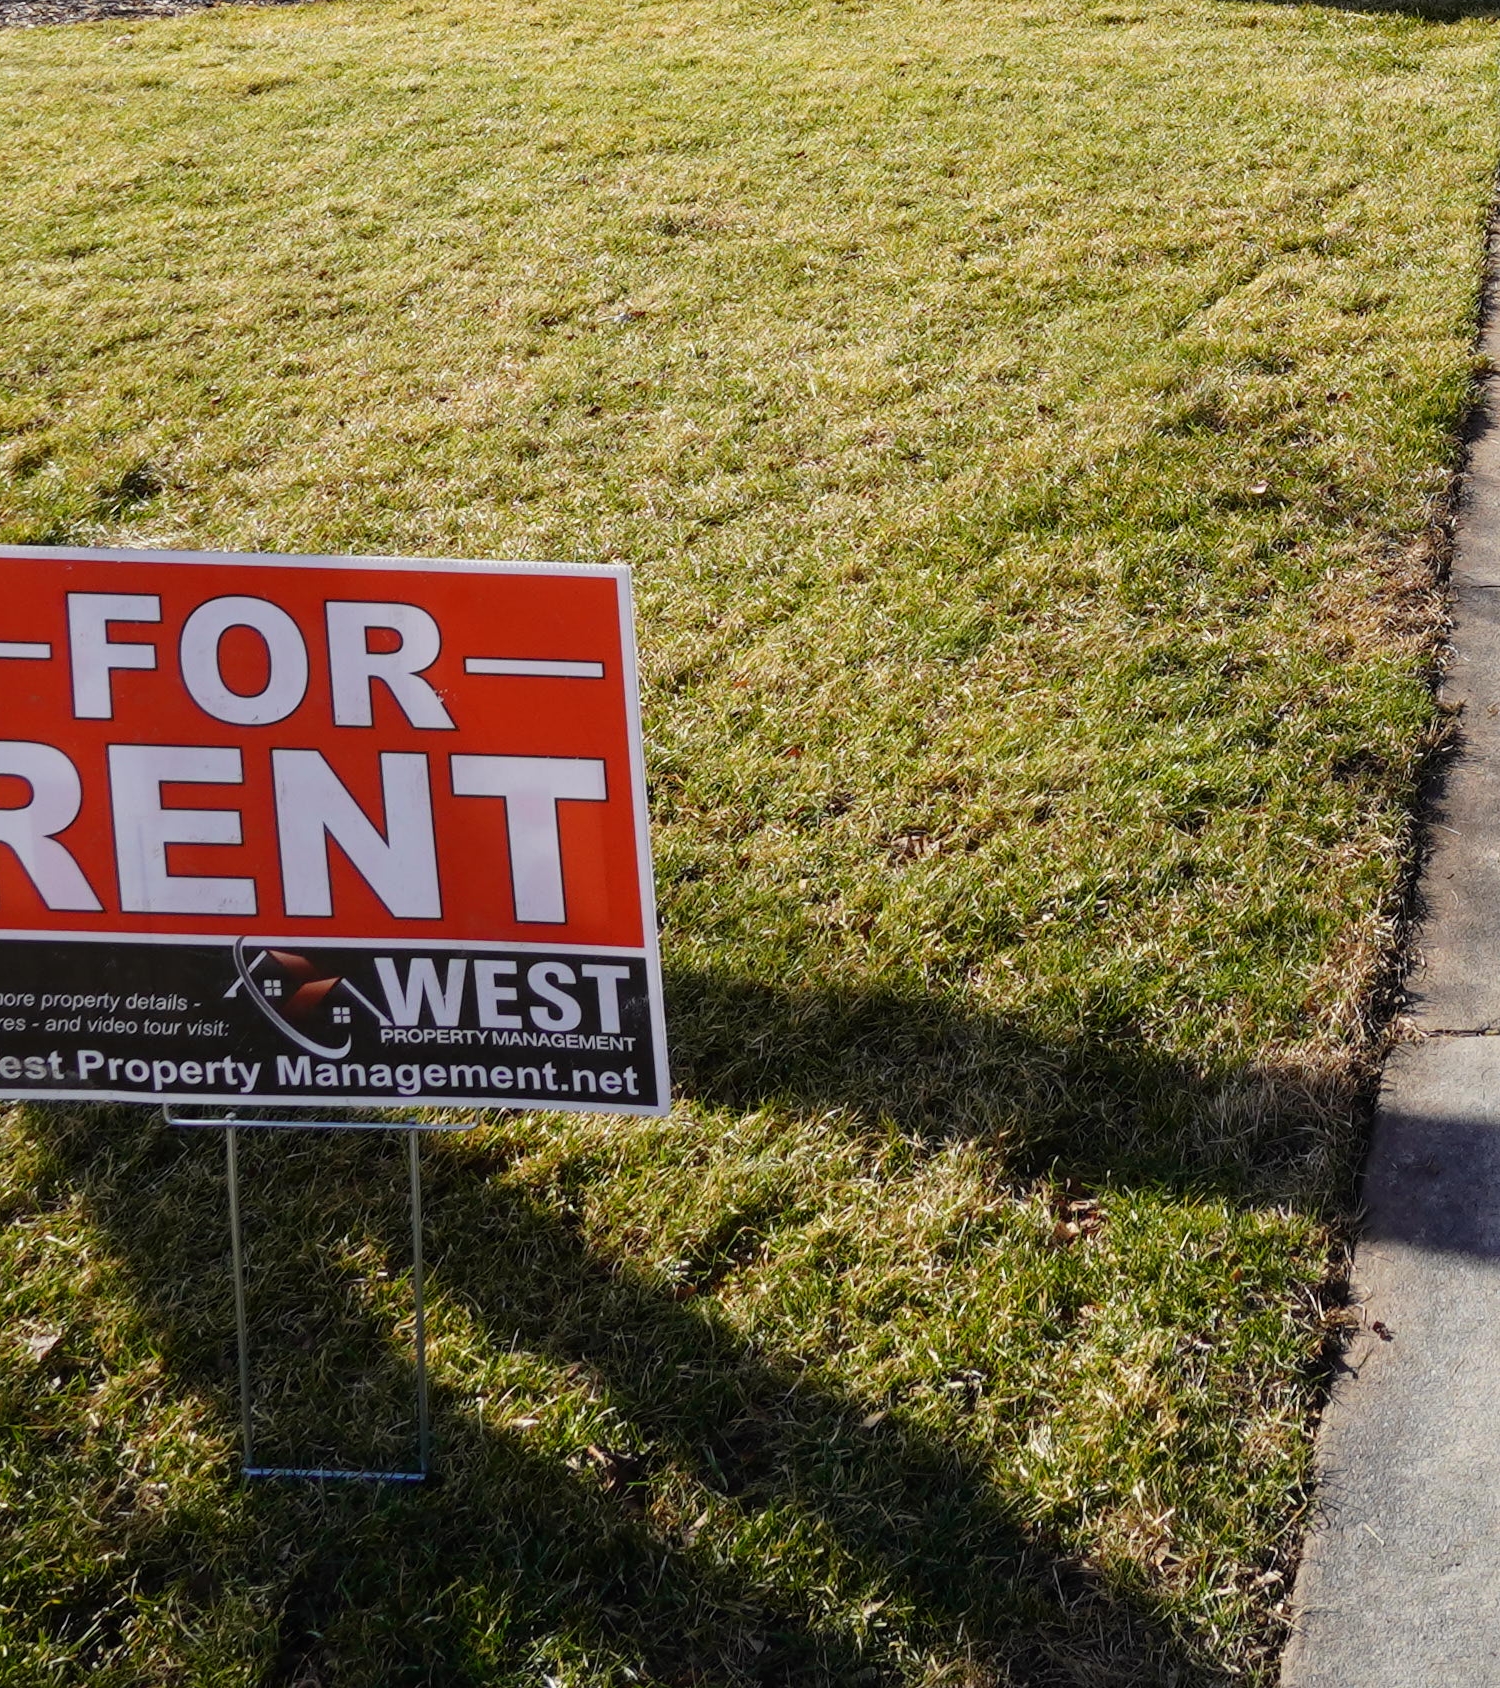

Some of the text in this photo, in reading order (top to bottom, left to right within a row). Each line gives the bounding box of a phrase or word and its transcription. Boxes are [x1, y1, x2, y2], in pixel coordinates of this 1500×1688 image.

[66, 592, 458, 730] FOR
[40, 993, 120, 1013] property
[125, 994, 188, 1011] details
[373, 957, 631, 1034] WEST
[45, 1016, 81, 1032] and
[87, 1017, 138, 1034] video
[143, 1019, 182, 1036] tour
[186, 1020, 230, 1037] visit:
[380, 1028, 637, 1052] PROPERTY MANAGEMENT
[77, 1049, 261, 1093] Property
[276, 1055, 640, 1096] Management.net
